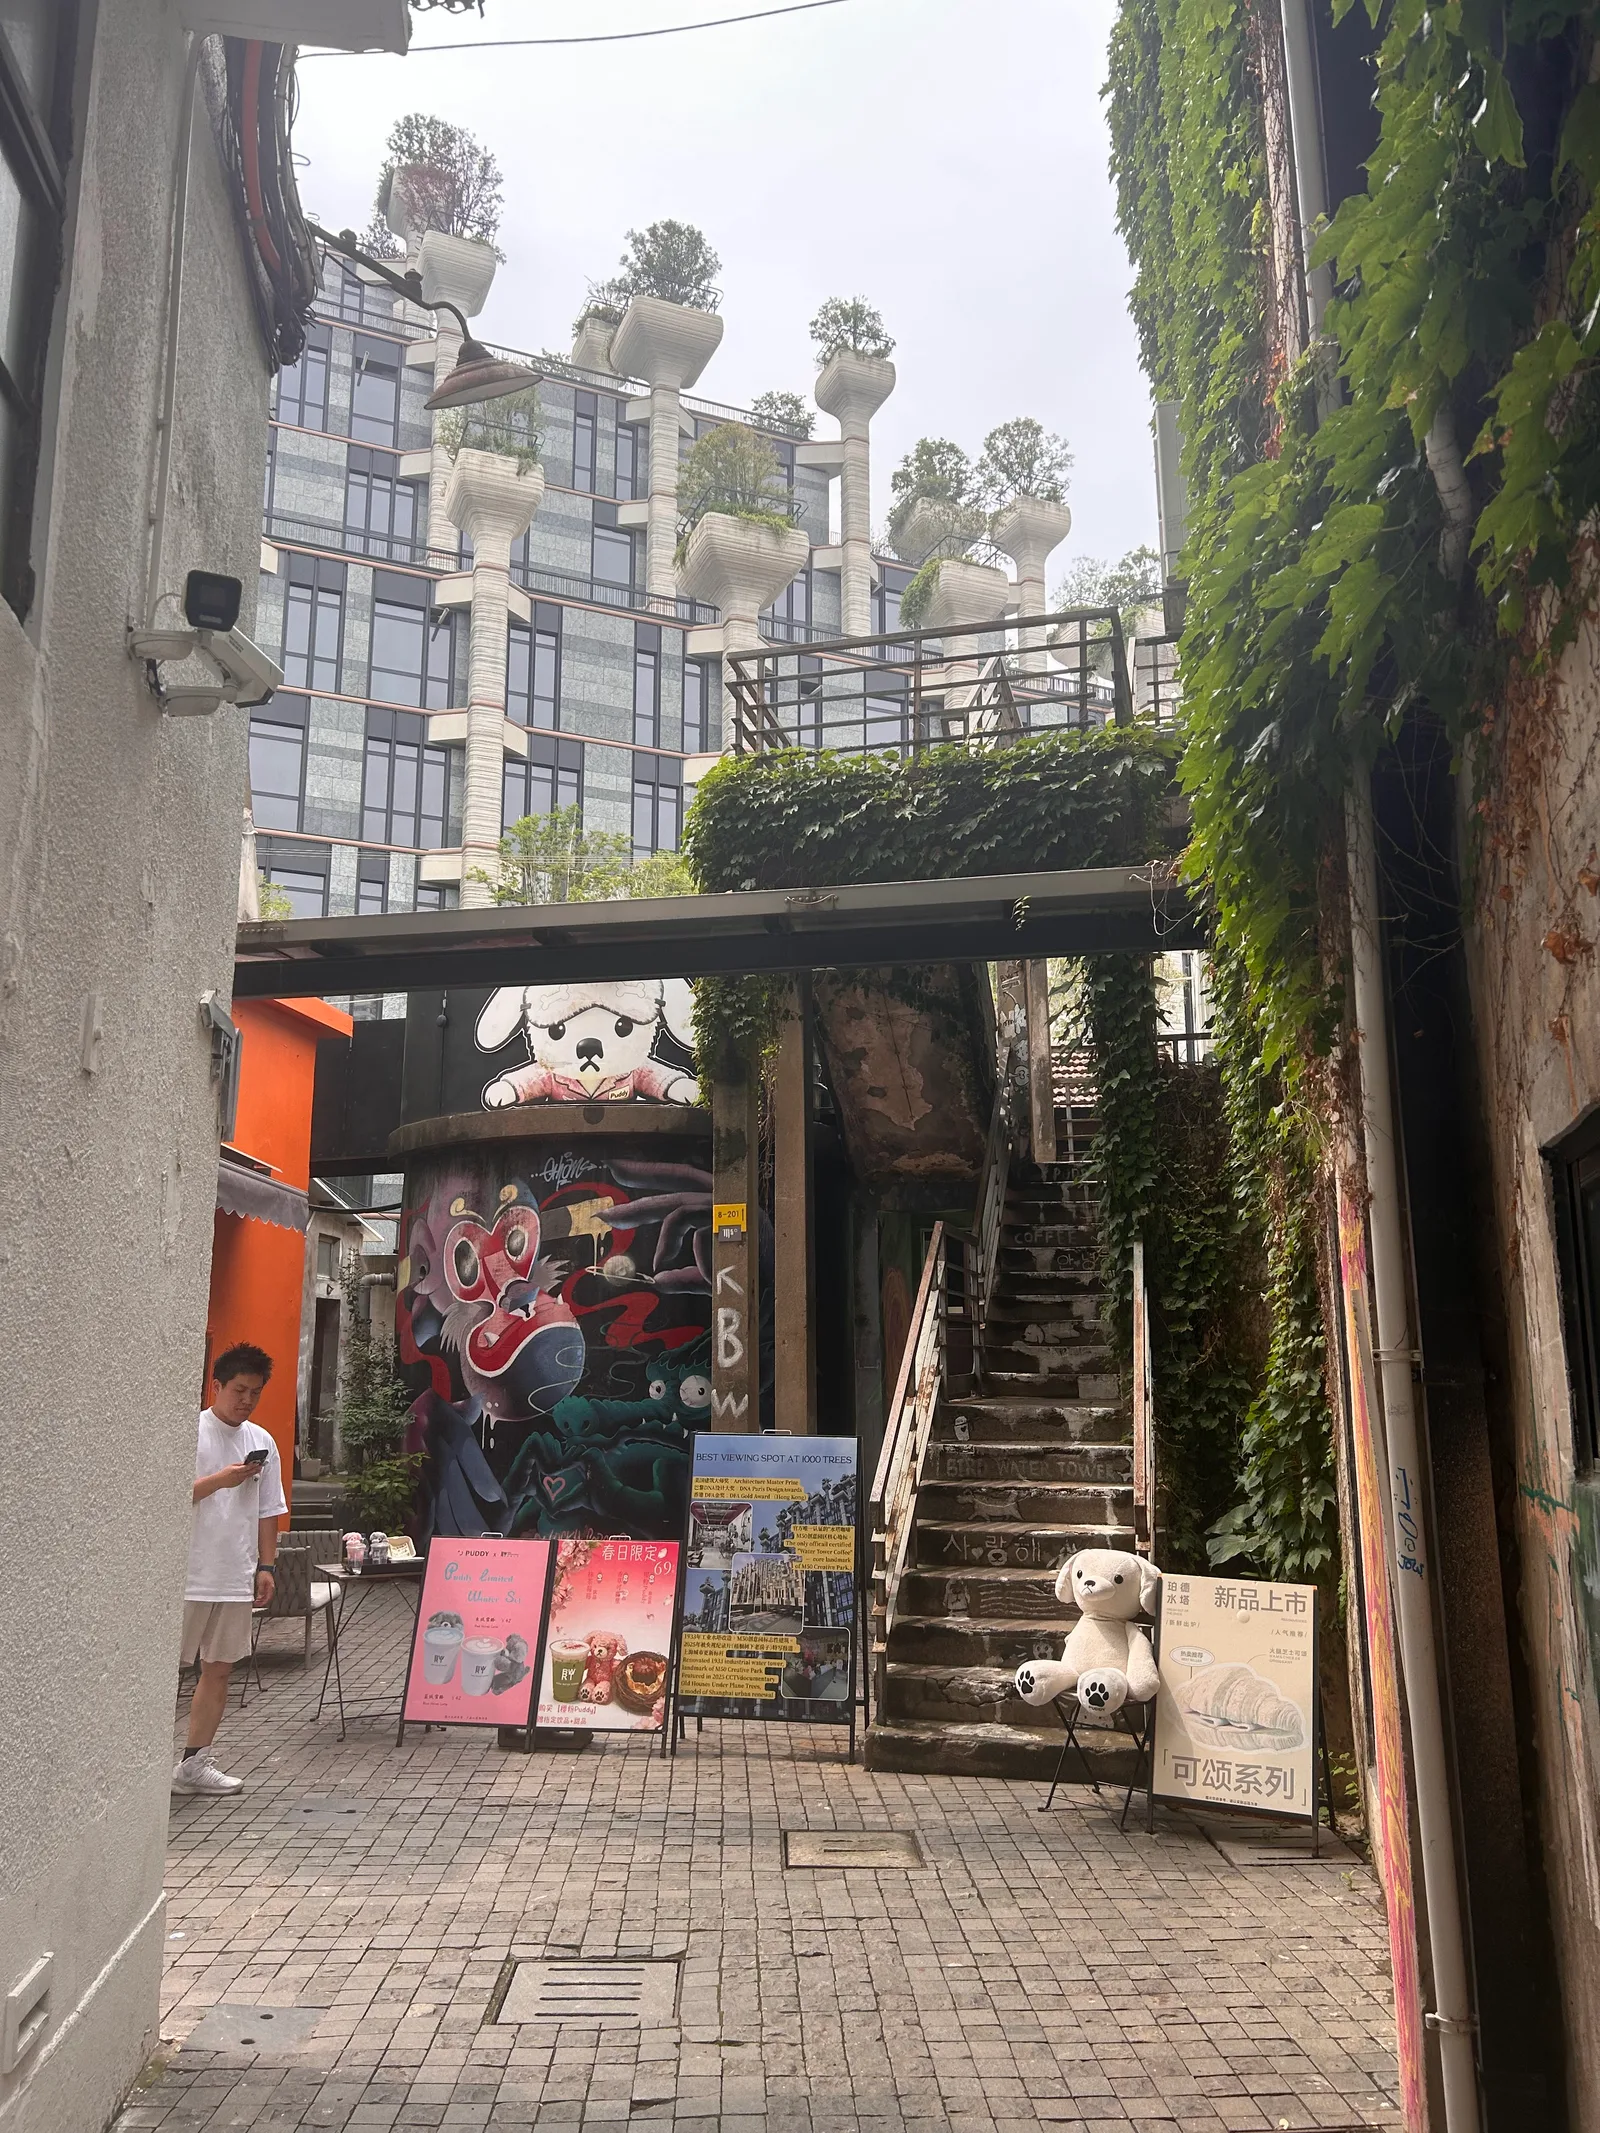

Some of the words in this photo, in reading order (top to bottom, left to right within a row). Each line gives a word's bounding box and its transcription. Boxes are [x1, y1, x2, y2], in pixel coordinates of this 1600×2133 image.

[610, 1089, 628, 1099] Puddy
[717, 1210, 739, 1218] 8-201
[1014, 1230, 1078, 1245] COFFEE
[696, 1453, 719, 1461] BEST
[721, 1454, 759, 1463] VIEWING
[761, 1454, 785, 1463] SPOT
[787, 1455, 800, 1463] AT
[801, 1455, 822, 1464] 1000
[822, 1456, 852, 1464] TREES
[1057, 1461, 1117, 1481] TOWER
[602, 1543, 657, 1562] 春日限定
[653, 1561, 672, 1575] 69
[479, 1568, 514, 1583] Limited
[1167, 1581, 1190, 1593] 珀德
[467, 1590, 499, 1603] Winter
[1166, 1593, 1190, 1606] 水塔
[1214, 1585, 1308, 1615] 新品上市
[708, 1689, 734, 1697] Shanghai
